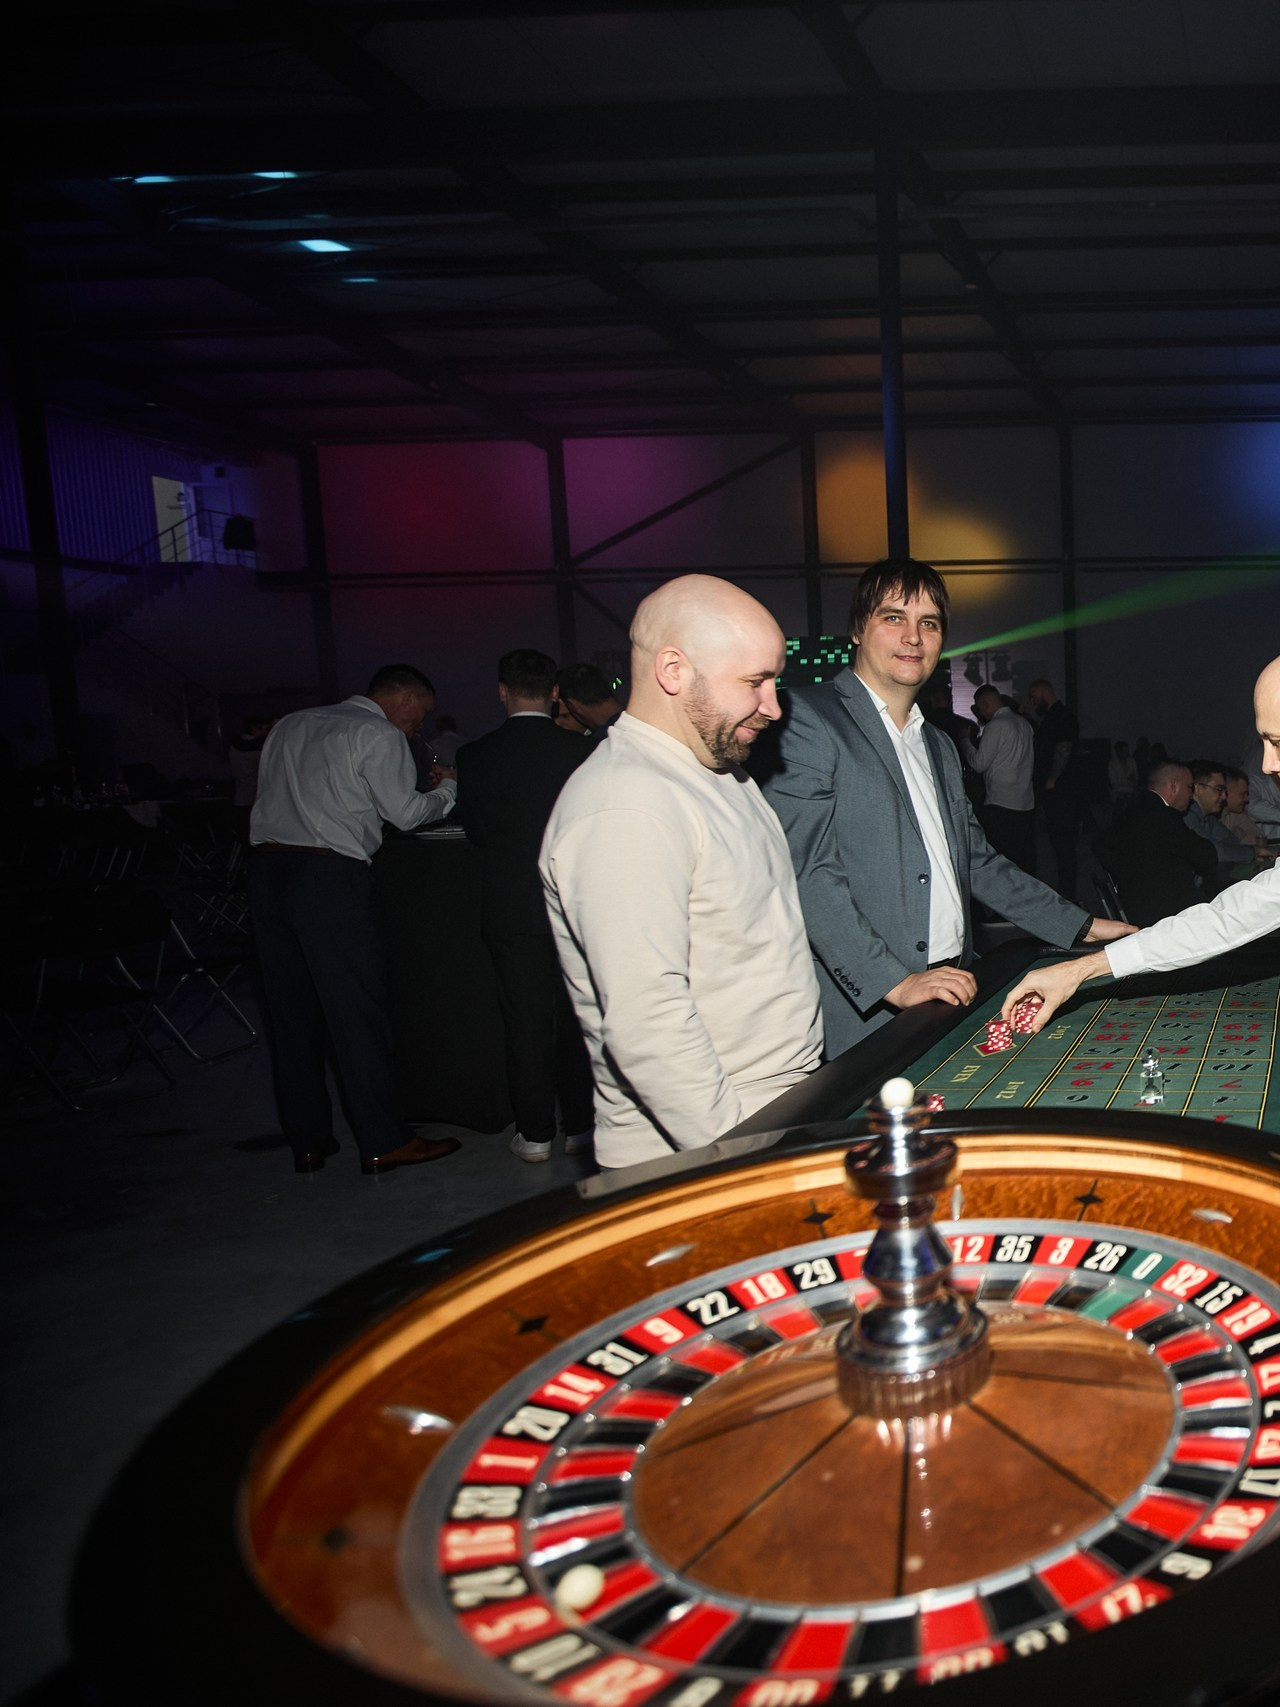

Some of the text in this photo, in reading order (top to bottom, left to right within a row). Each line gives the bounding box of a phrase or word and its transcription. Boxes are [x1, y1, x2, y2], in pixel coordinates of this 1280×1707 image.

[1217, 1035, 1264, 1043] 16
[950, 1065, 981, 1083] EVEN
[1073, 1062, 1121, 1070] 12
[1210, 1063, 1256, 1071] 10
[1219, 1078, 1243, 1088] 7
[1212, 1096, 1239, 1106] 4
[951, 1236, 984, 1263] 12
[995, 1235, 1035, 1262] 35
[1048, 1237, 1075, 1265] 3
[1083, 1241, 1127, 1273] 26
[792, 1257, 837, 1291] 29
[1132, 1252, 1163, 1280] 0
[1161, 1263, 1208, 1297] 32
[741, 1272, 787, 1305] 18
[1194, 1280, 1244, 1315] 15
[686, 1290, 740, 1326] 22
[1222, 1301, 1271, 1335] 19
[643, 1317, 684, 1344] 9
[586, 1342, 650, 1376] 31
[543, 1372, 606, 1406] 14
[502, 1405, 571, 1442] 20
[478, 1453, 539, 1471] 1
